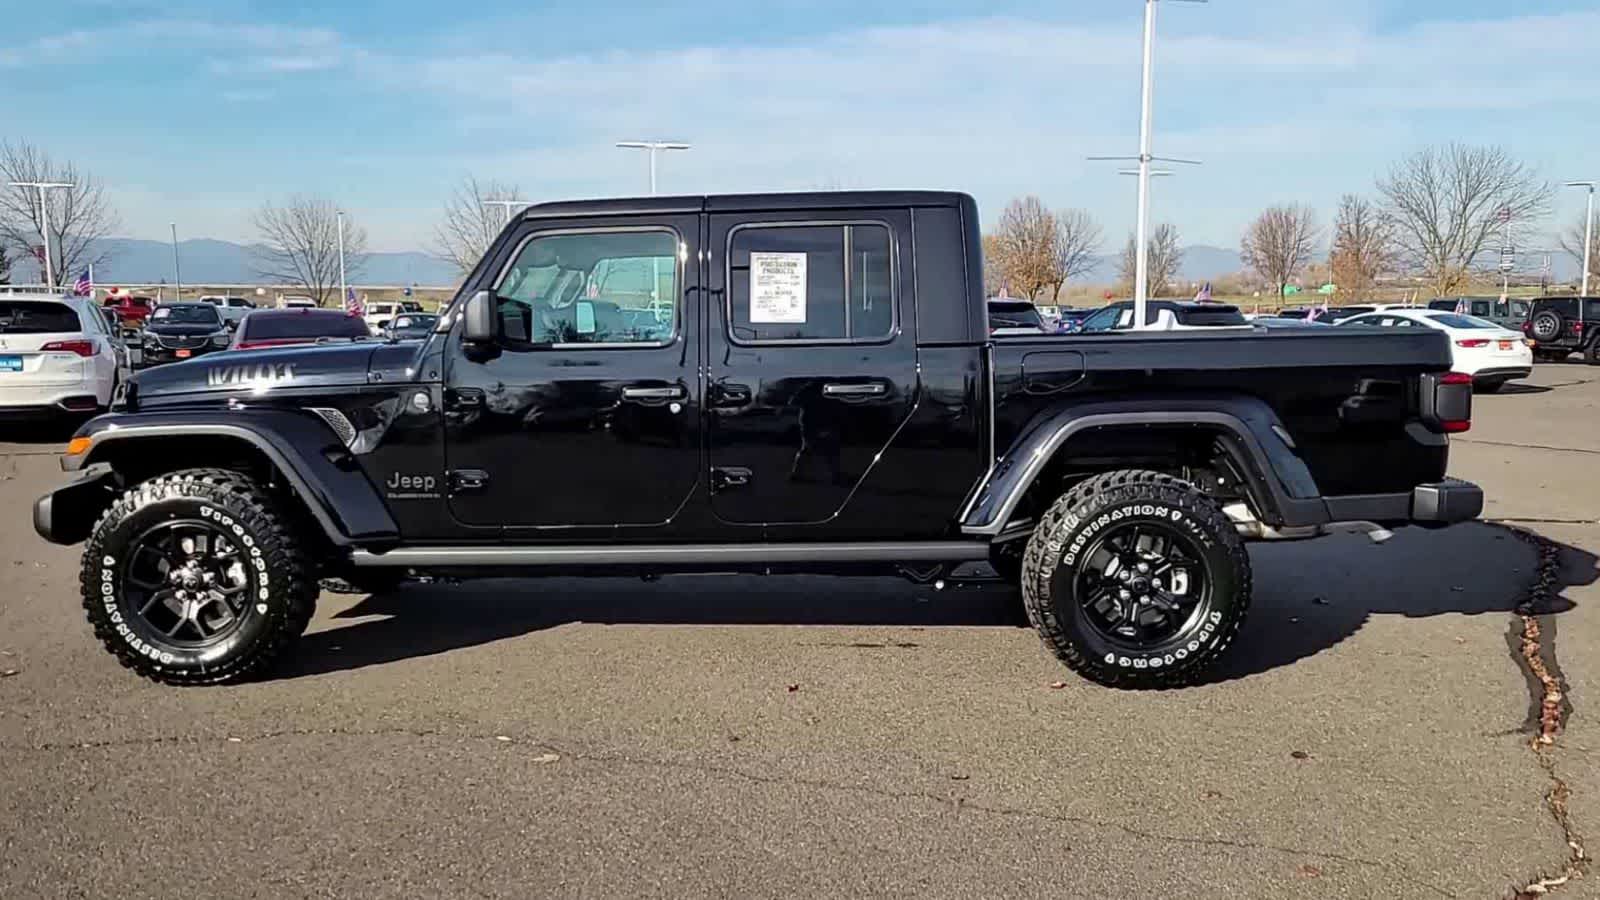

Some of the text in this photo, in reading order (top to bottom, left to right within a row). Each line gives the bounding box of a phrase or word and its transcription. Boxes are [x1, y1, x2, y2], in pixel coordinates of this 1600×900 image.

[387, 471, 436, 492] Jeep
[200, 505, 269, 600] Firestone
[1063, 505, 1168, 566] DESTINATION
[101, 568, 173, 664] DESTINATION
[1118, 610, 1222, 669] Firestone
